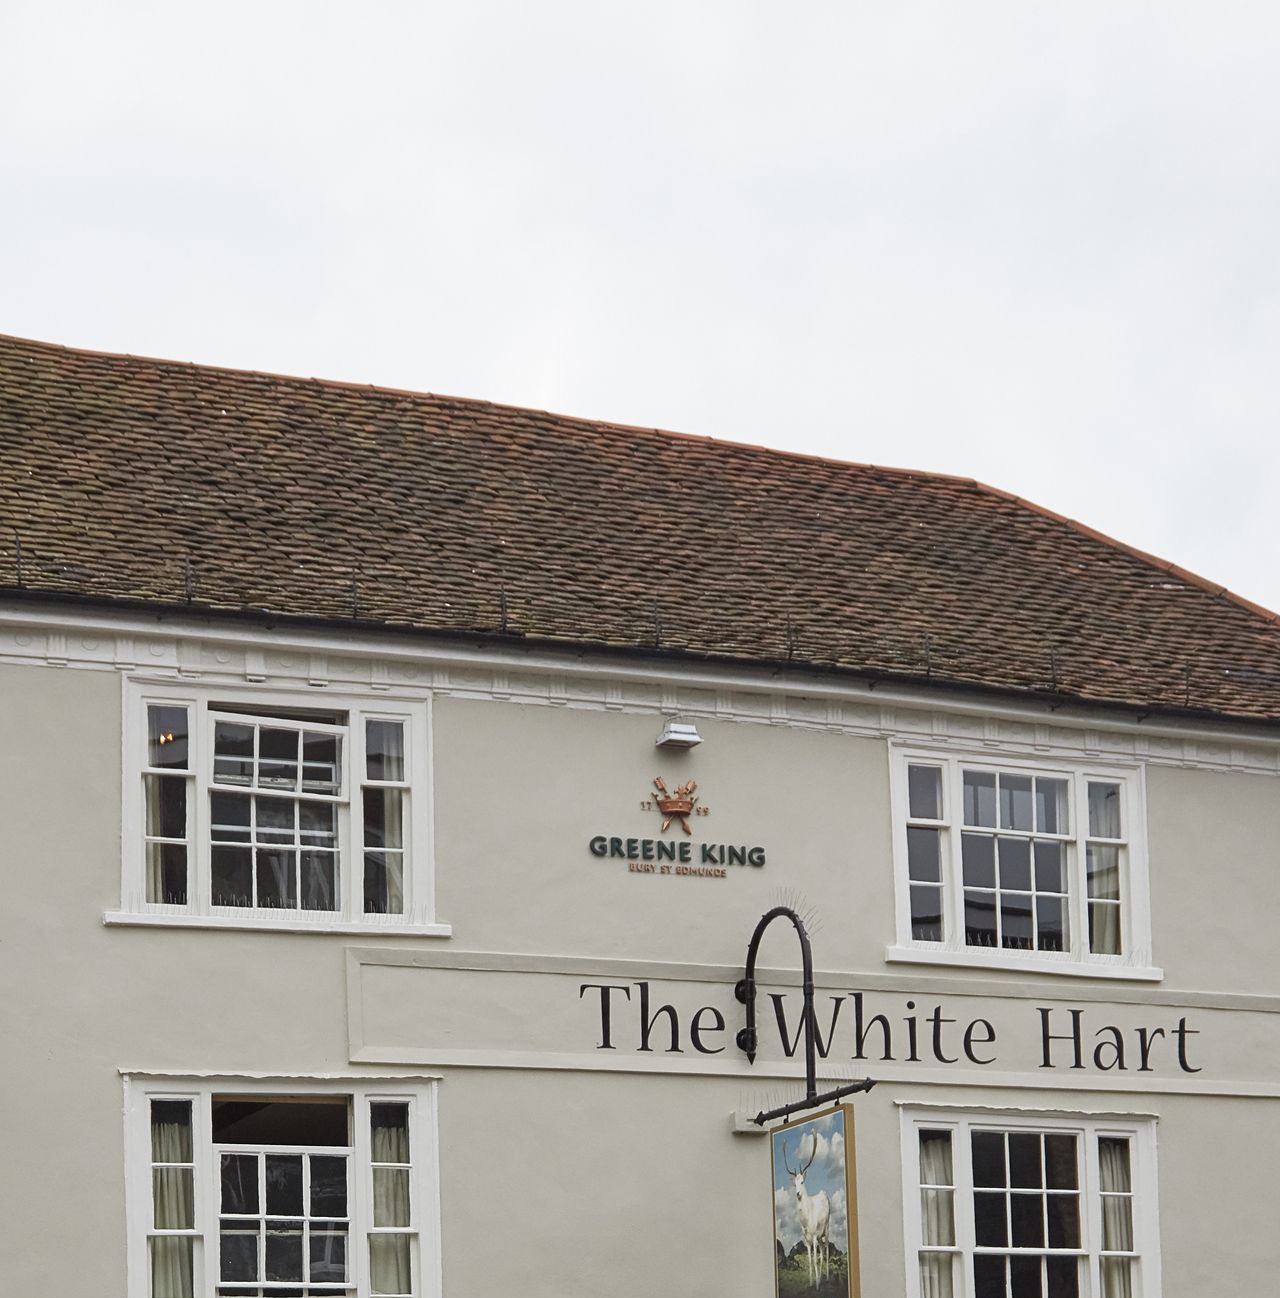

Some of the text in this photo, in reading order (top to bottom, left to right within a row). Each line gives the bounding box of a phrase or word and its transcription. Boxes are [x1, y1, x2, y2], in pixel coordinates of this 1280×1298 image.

[589, 835, 766, 867] GREENE KING
[629, 863, 727, 878] BURY ST EDMUNDS
[580, 982, 1203, 1073] The White Hart
